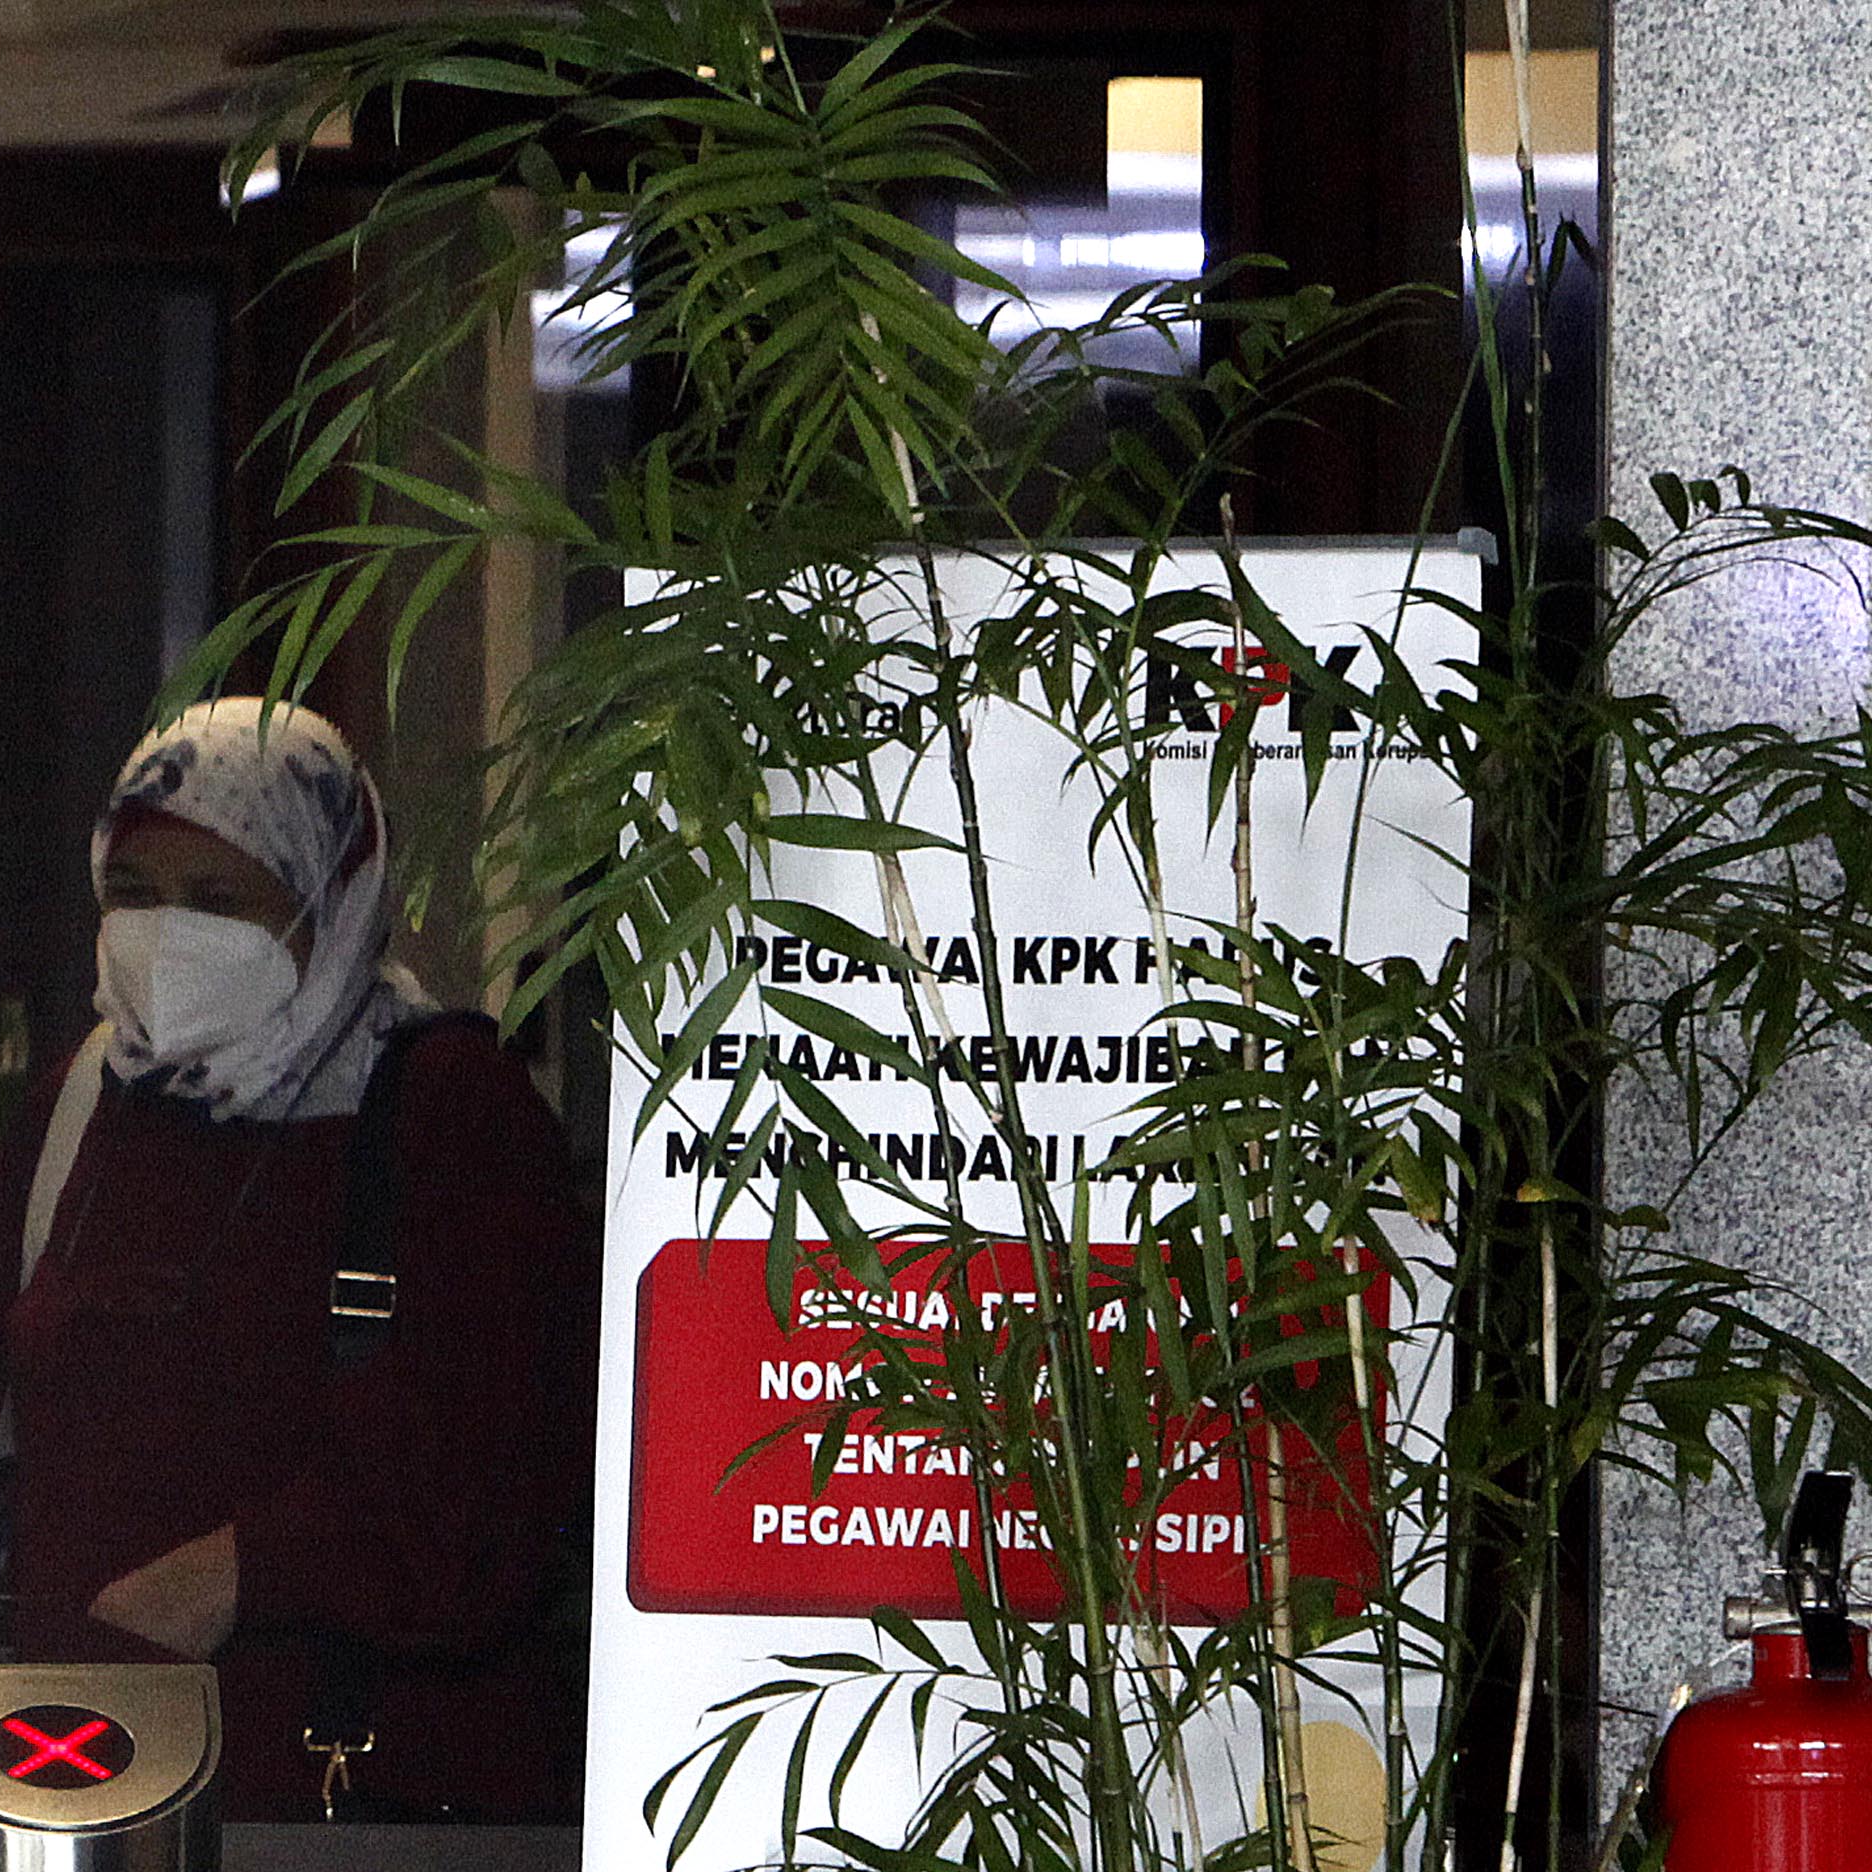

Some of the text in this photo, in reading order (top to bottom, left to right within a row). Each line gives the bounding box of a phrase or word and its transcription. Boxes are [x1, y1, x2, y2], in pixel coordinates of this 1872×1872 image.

[735, 936, 996, 984] PEGAA
[1013, 936, 1118, 984] KPK
[665, 1131, 1058, 1182] MENHINDAI
[798, 1289, 960, 1331] SESUA
[760, 1360, 928, 1401] NOM
[752, 1504, 970, 1548] PEGAWAI
